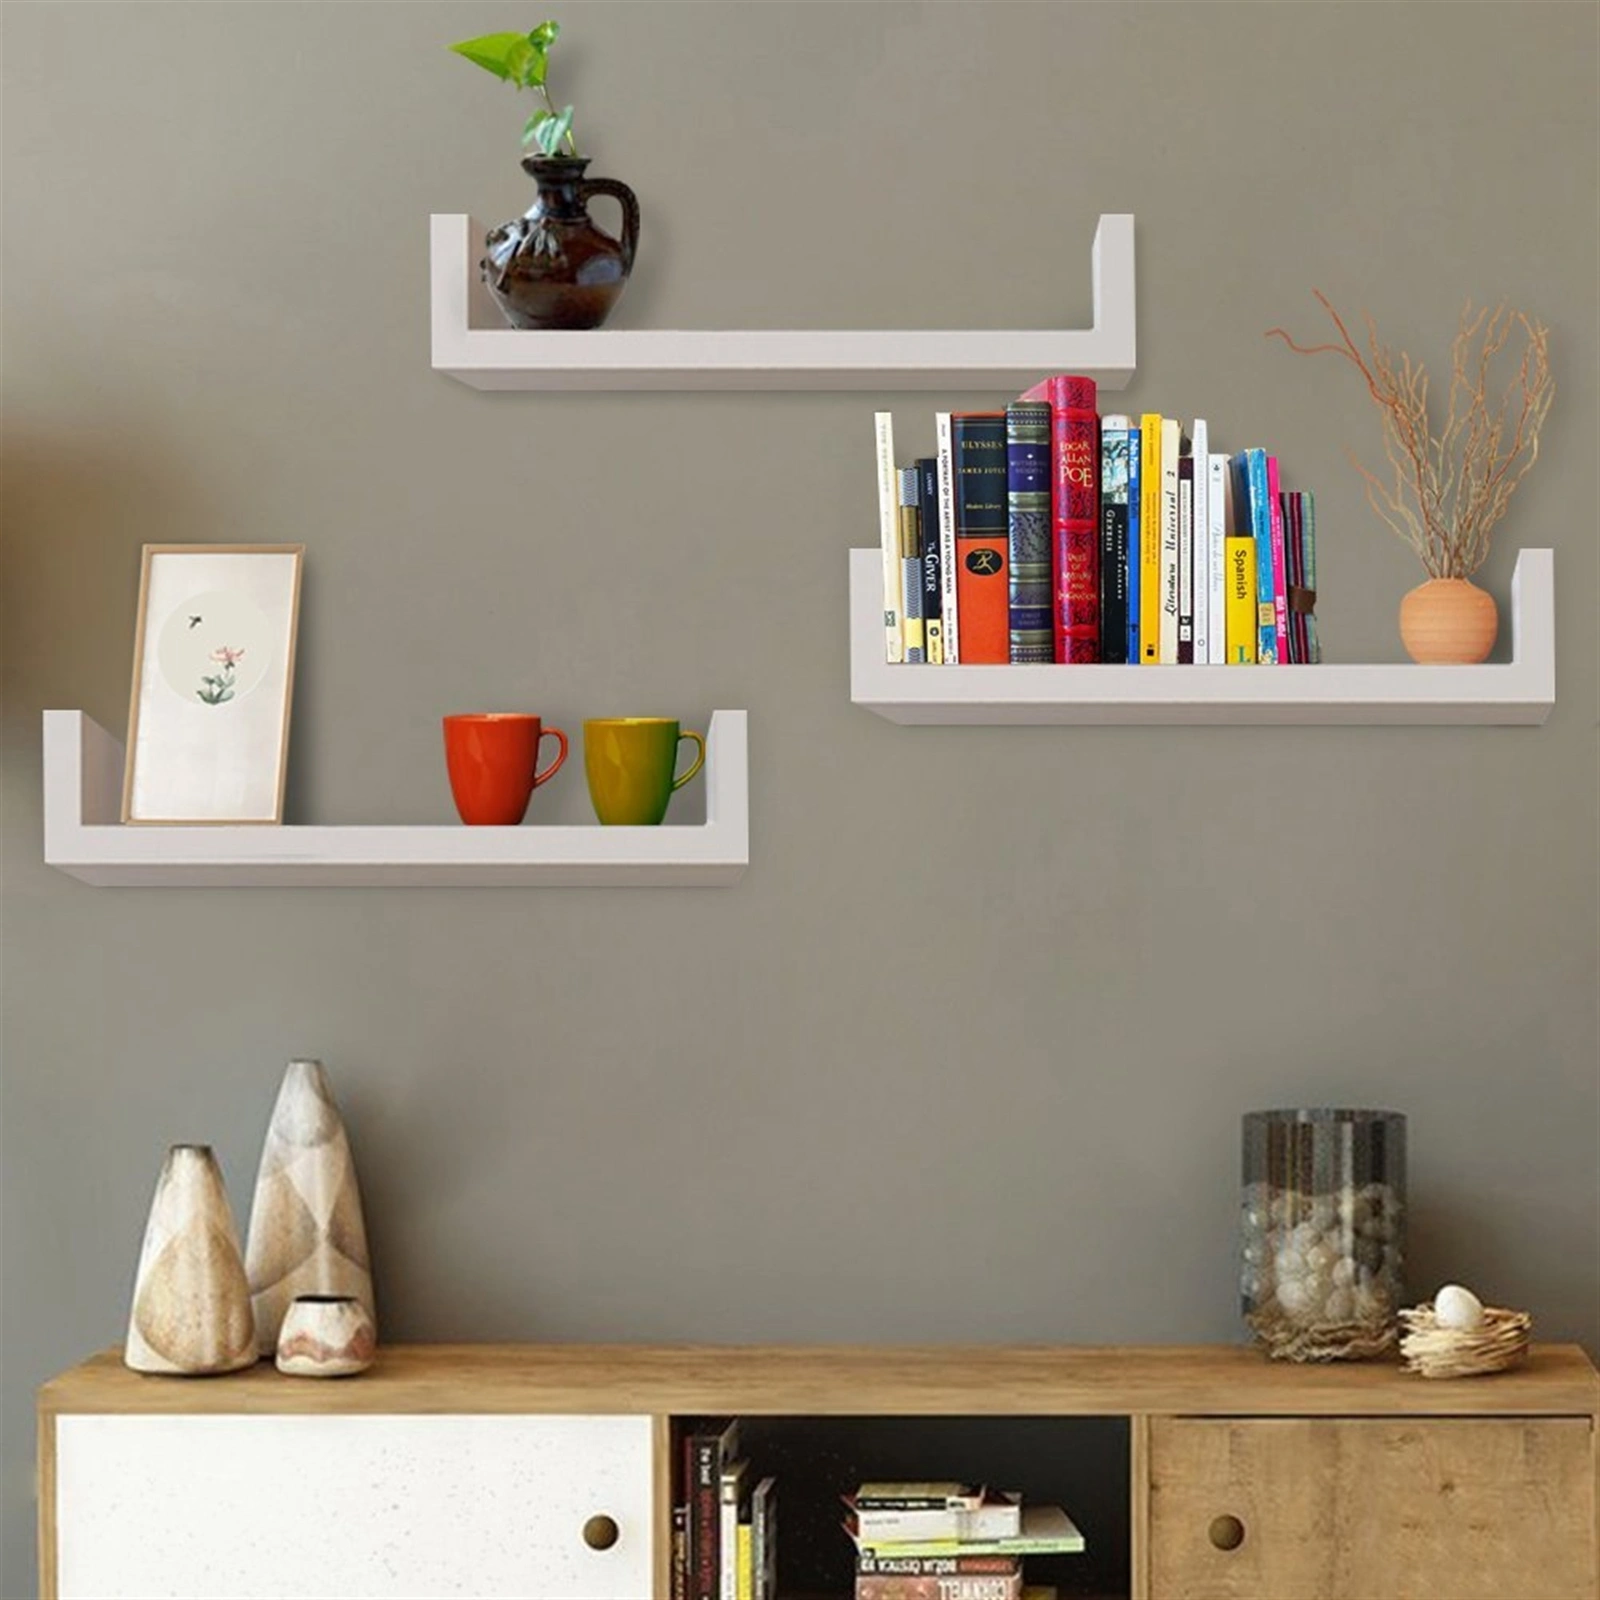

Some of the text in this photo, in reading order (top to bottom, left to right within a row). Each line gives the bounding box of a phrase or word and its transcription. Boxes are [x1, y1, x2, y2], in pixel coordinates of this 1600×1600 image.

[961, 440, 1004, 449] ULYSSES
[1060, 441, 1091, 453] EDGAR
[941, 455, 949, 486] PORTRAIT
[1061, 453, 1093, 465] ALLAN
[1060, 465, 1093, 487] POE
[943, 487, 950, 496] OF
[1106, 509, 1116, 551] GENESIS
[1165, 491, 1177, 551] Universal
[944, 533, 951, 543] AS
[925, 542, 939, 592] The GIVER
[1235, 550, 1247, 600] Spanish
[1164, 563, 1177, 616] Literatura
